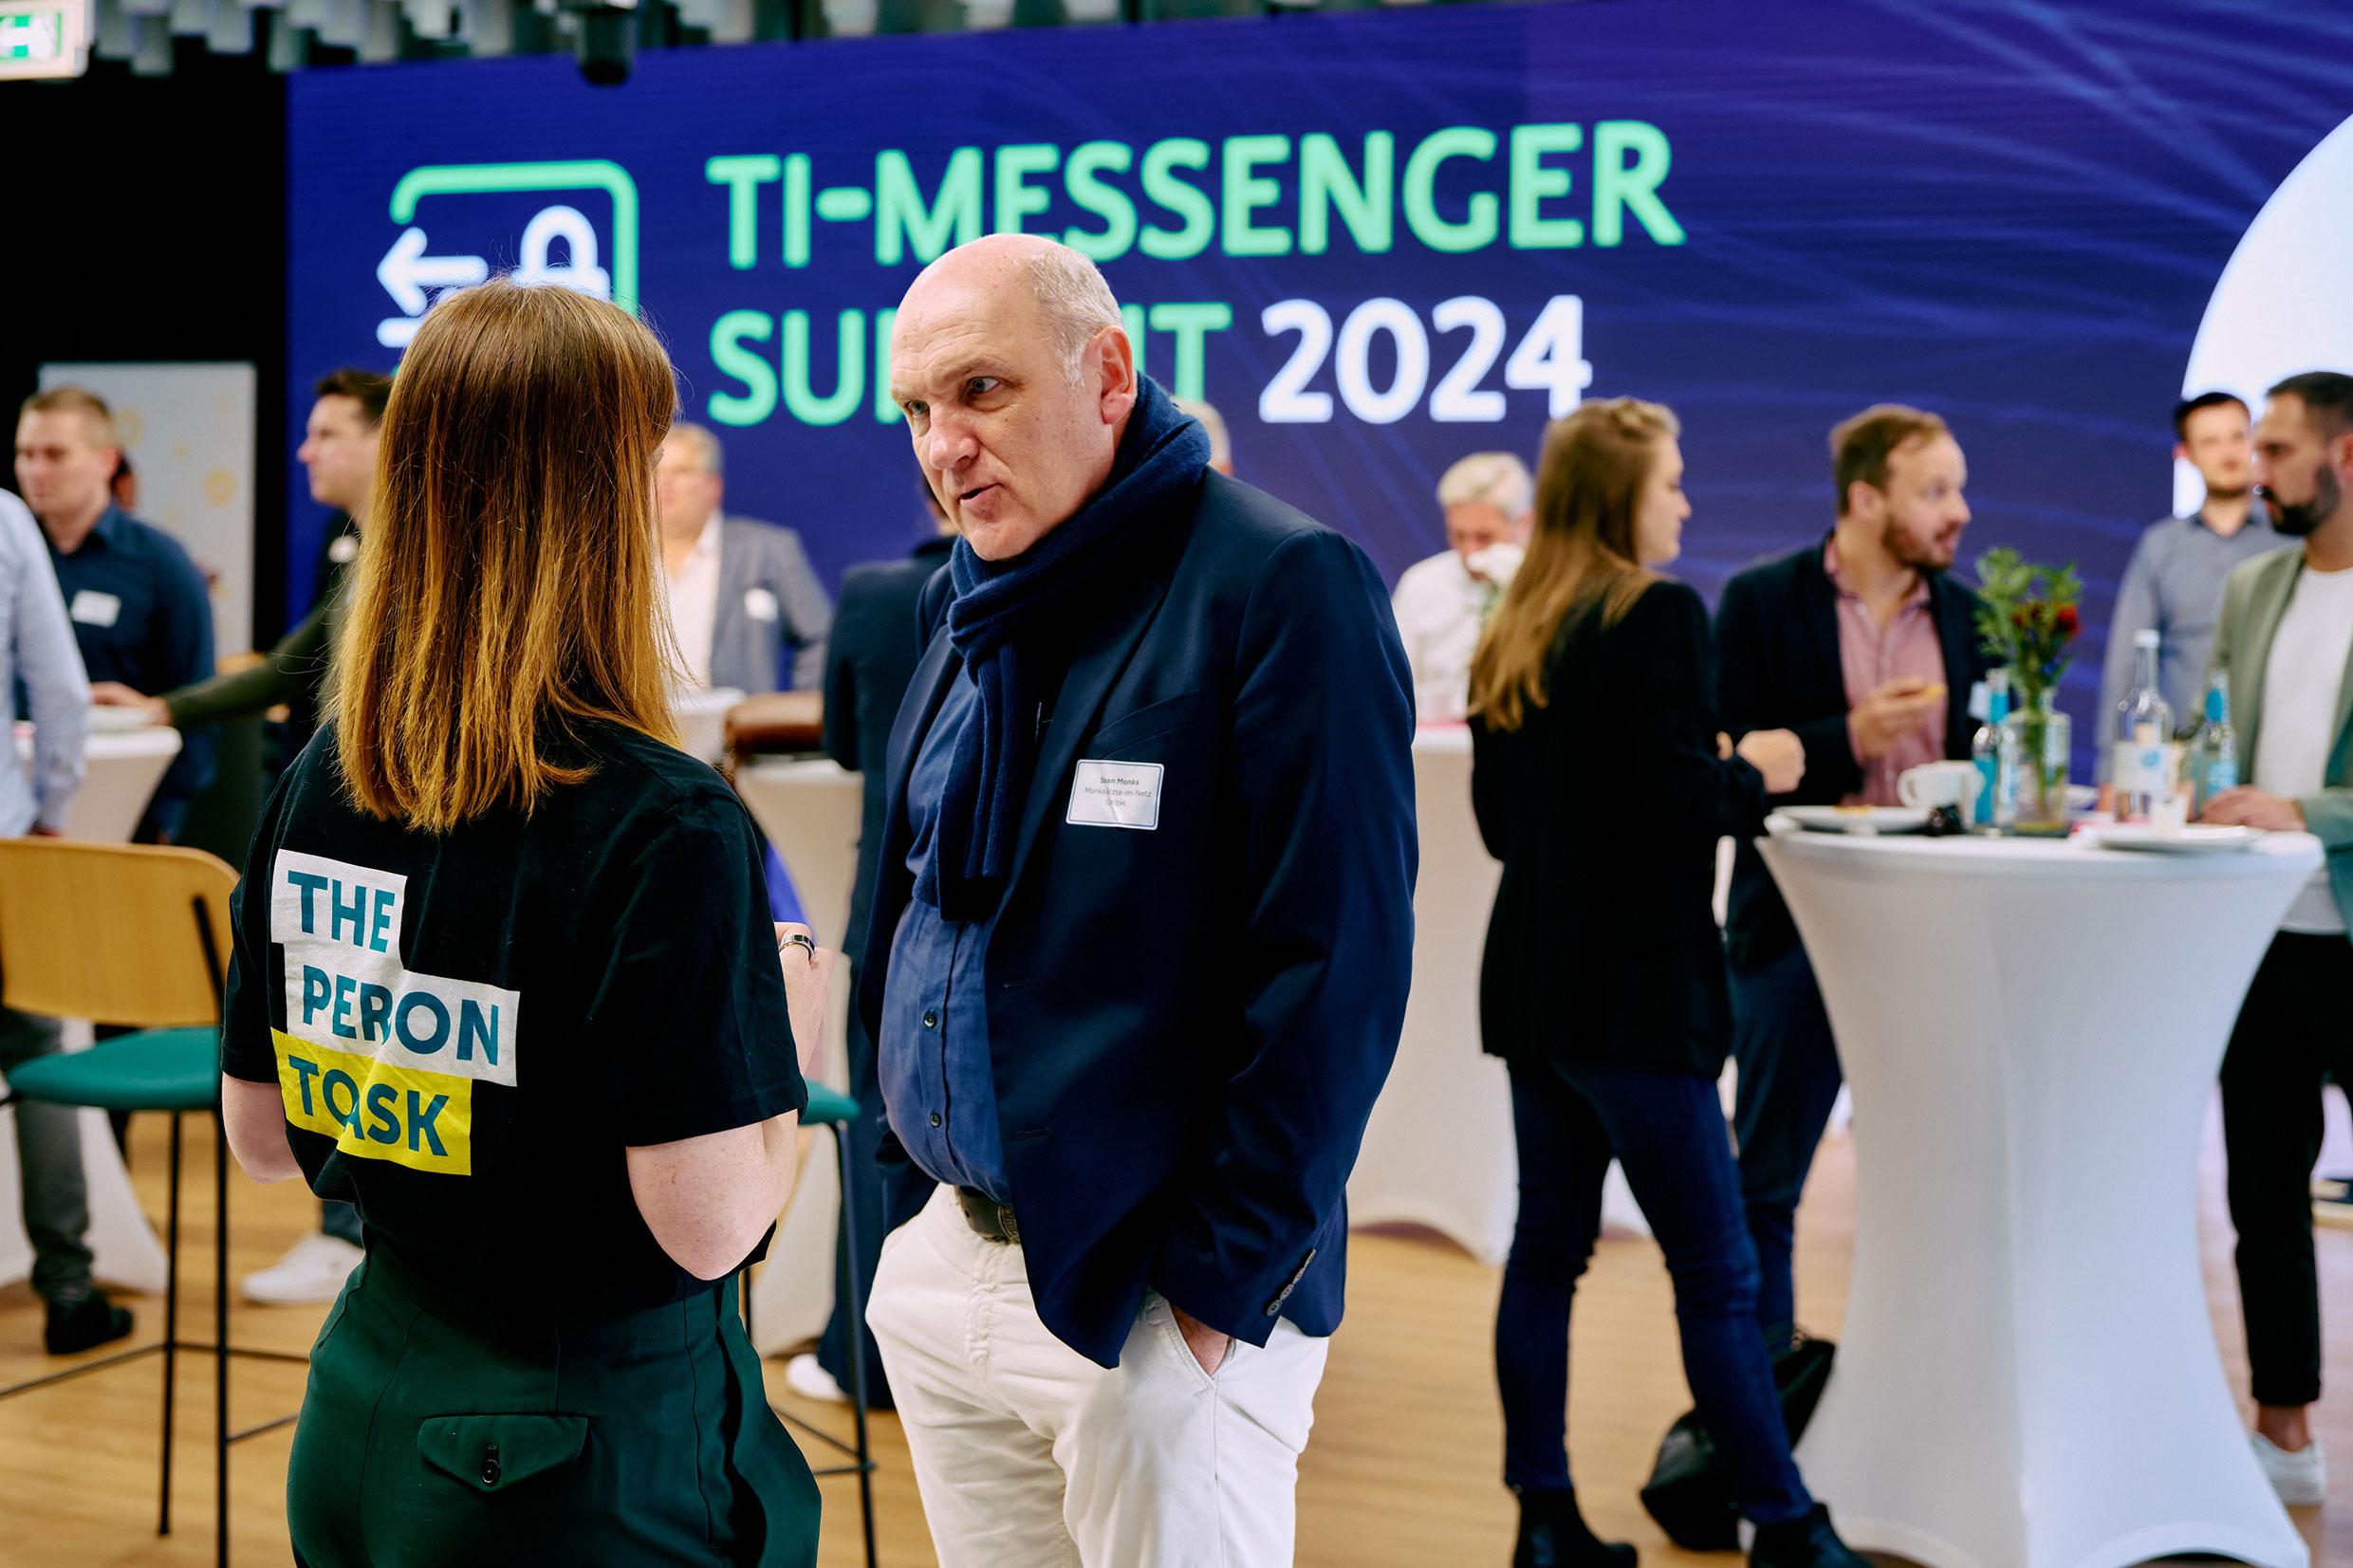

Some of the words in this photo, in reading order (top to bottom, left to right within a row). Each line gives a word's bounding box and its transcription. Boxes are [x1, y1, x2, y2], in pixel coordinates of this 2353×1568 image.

[705, 120, 1687, 269] TI-MESSENGER
[707, 302, 1232, 427] SUT
[1258, 294, 1593, 424] 2024
[287, 870, 396, 952] THE
[303, 964, 499, 1066] PERON
[287, 1054, 361, 1129] TO
